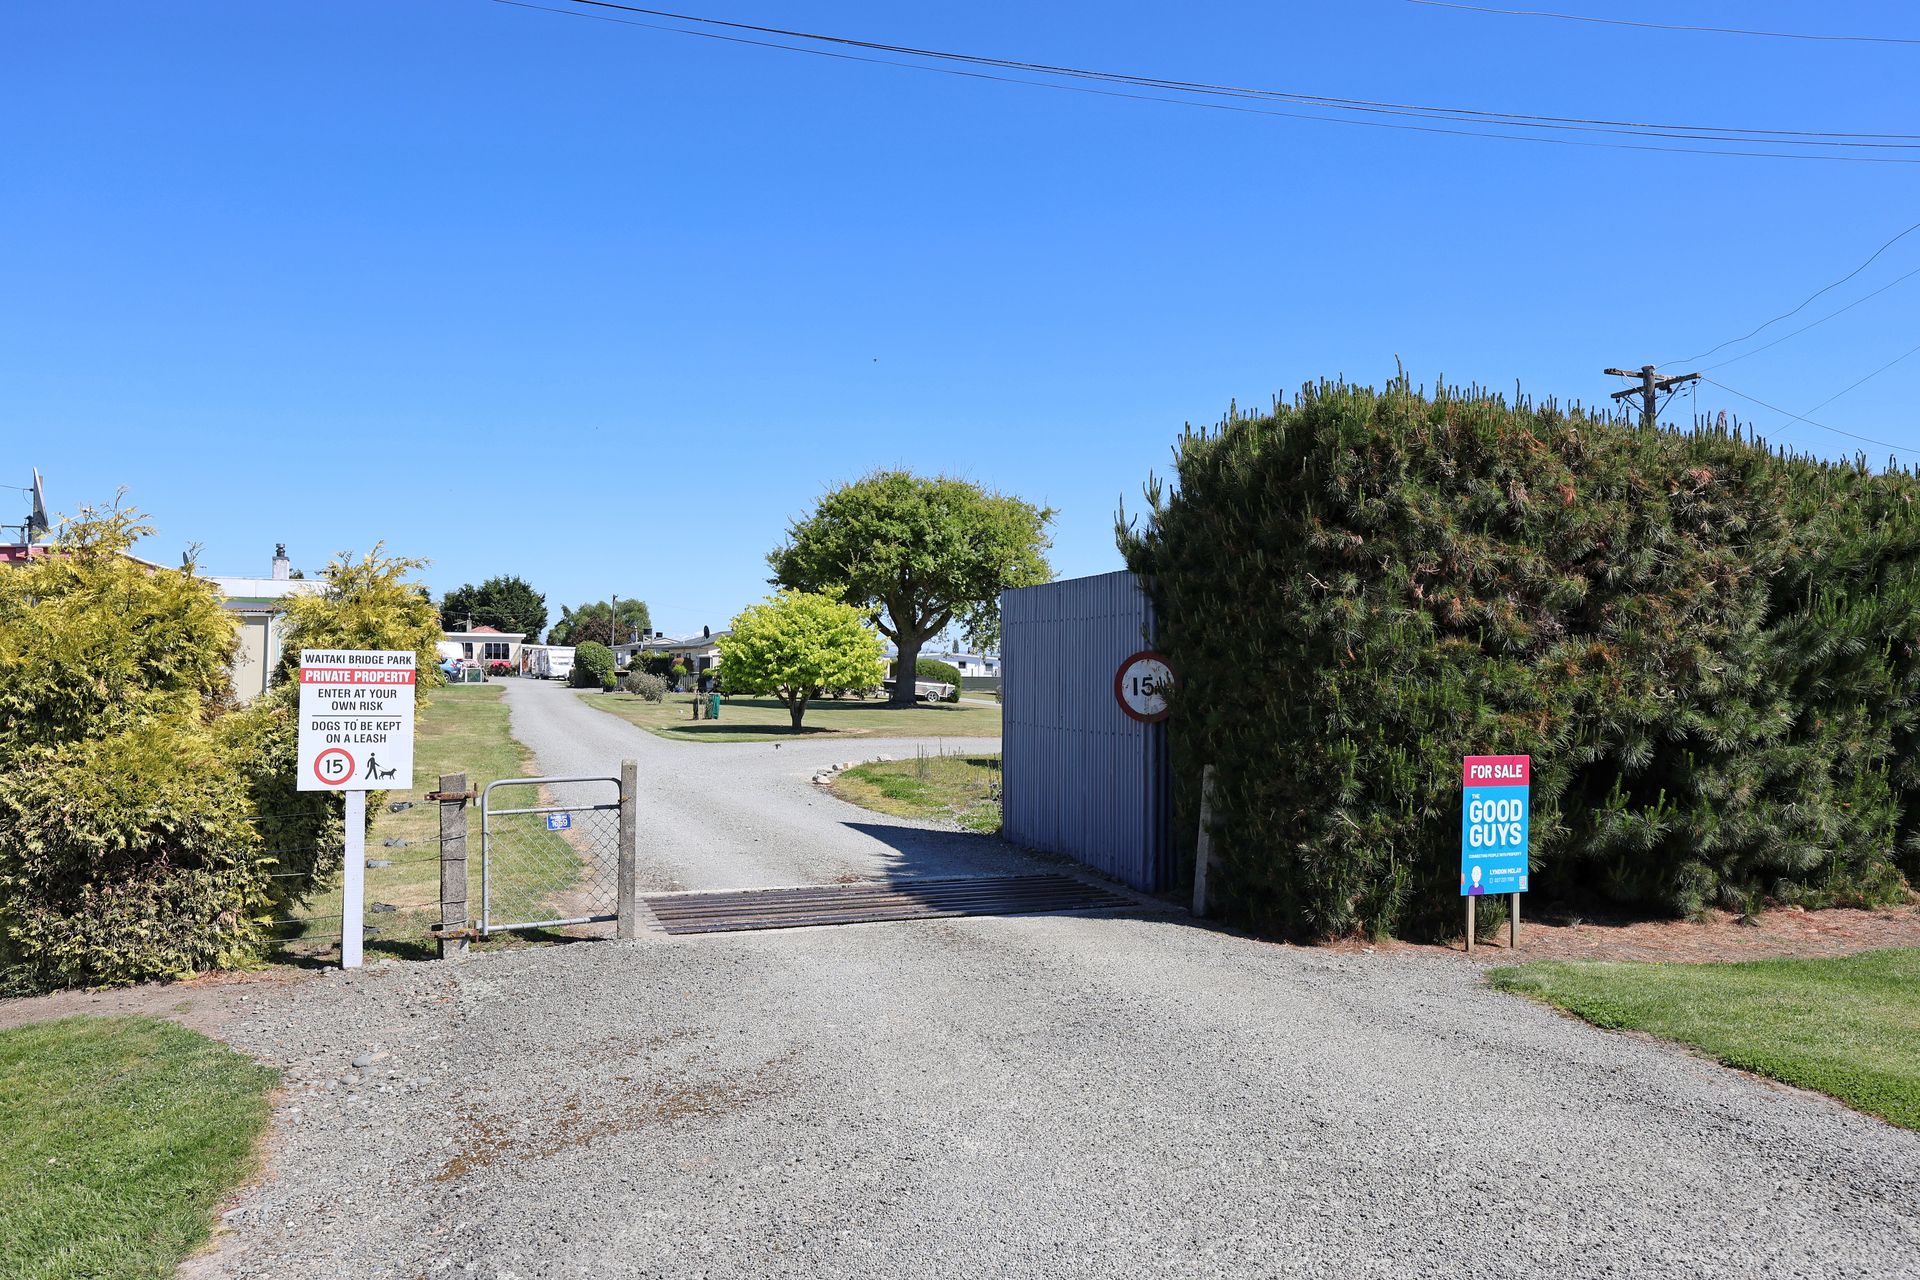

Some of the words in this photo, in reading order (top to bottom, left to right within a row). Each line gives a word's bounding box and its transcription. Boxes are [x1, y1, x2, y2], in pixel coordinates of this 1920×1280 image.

[305, 654, 345, 664] WAITAKI
[348, 655, 384, 664] BRIDGE
[387, 655, 412, 665] PARK
[305, 670, 351, 682] PRIVATE
[354, 670, 410, 682] PROPERTY
[1133, 676, 1154, 697] 15
[318, 689, 351, 698] ENTER
[354, 689, 366, 698] AT
[369, 689, 397, 698] YOUR
[332, 701, 356, 711] OWN
[359, 701, 383, 711] RISK
[312, 721, 341, 731] DOGS
[344, 721, 357, 731] TO
[360, 721, 373, 731] BE
[376, 721, 401, 731] KEPT
[326, 734, 340, 743] ON
[344, 734, 350, 743] A
[354, 734, 387, 743] LEASH
[326, 759, 343, 774] 15
[1470, 765, 1492, 779] FOR
[1494, 764, 1523, 778] SALE
[1469, 799, 1523, 823] GOOD
[1469, 822, 1522, 848] GUYS
